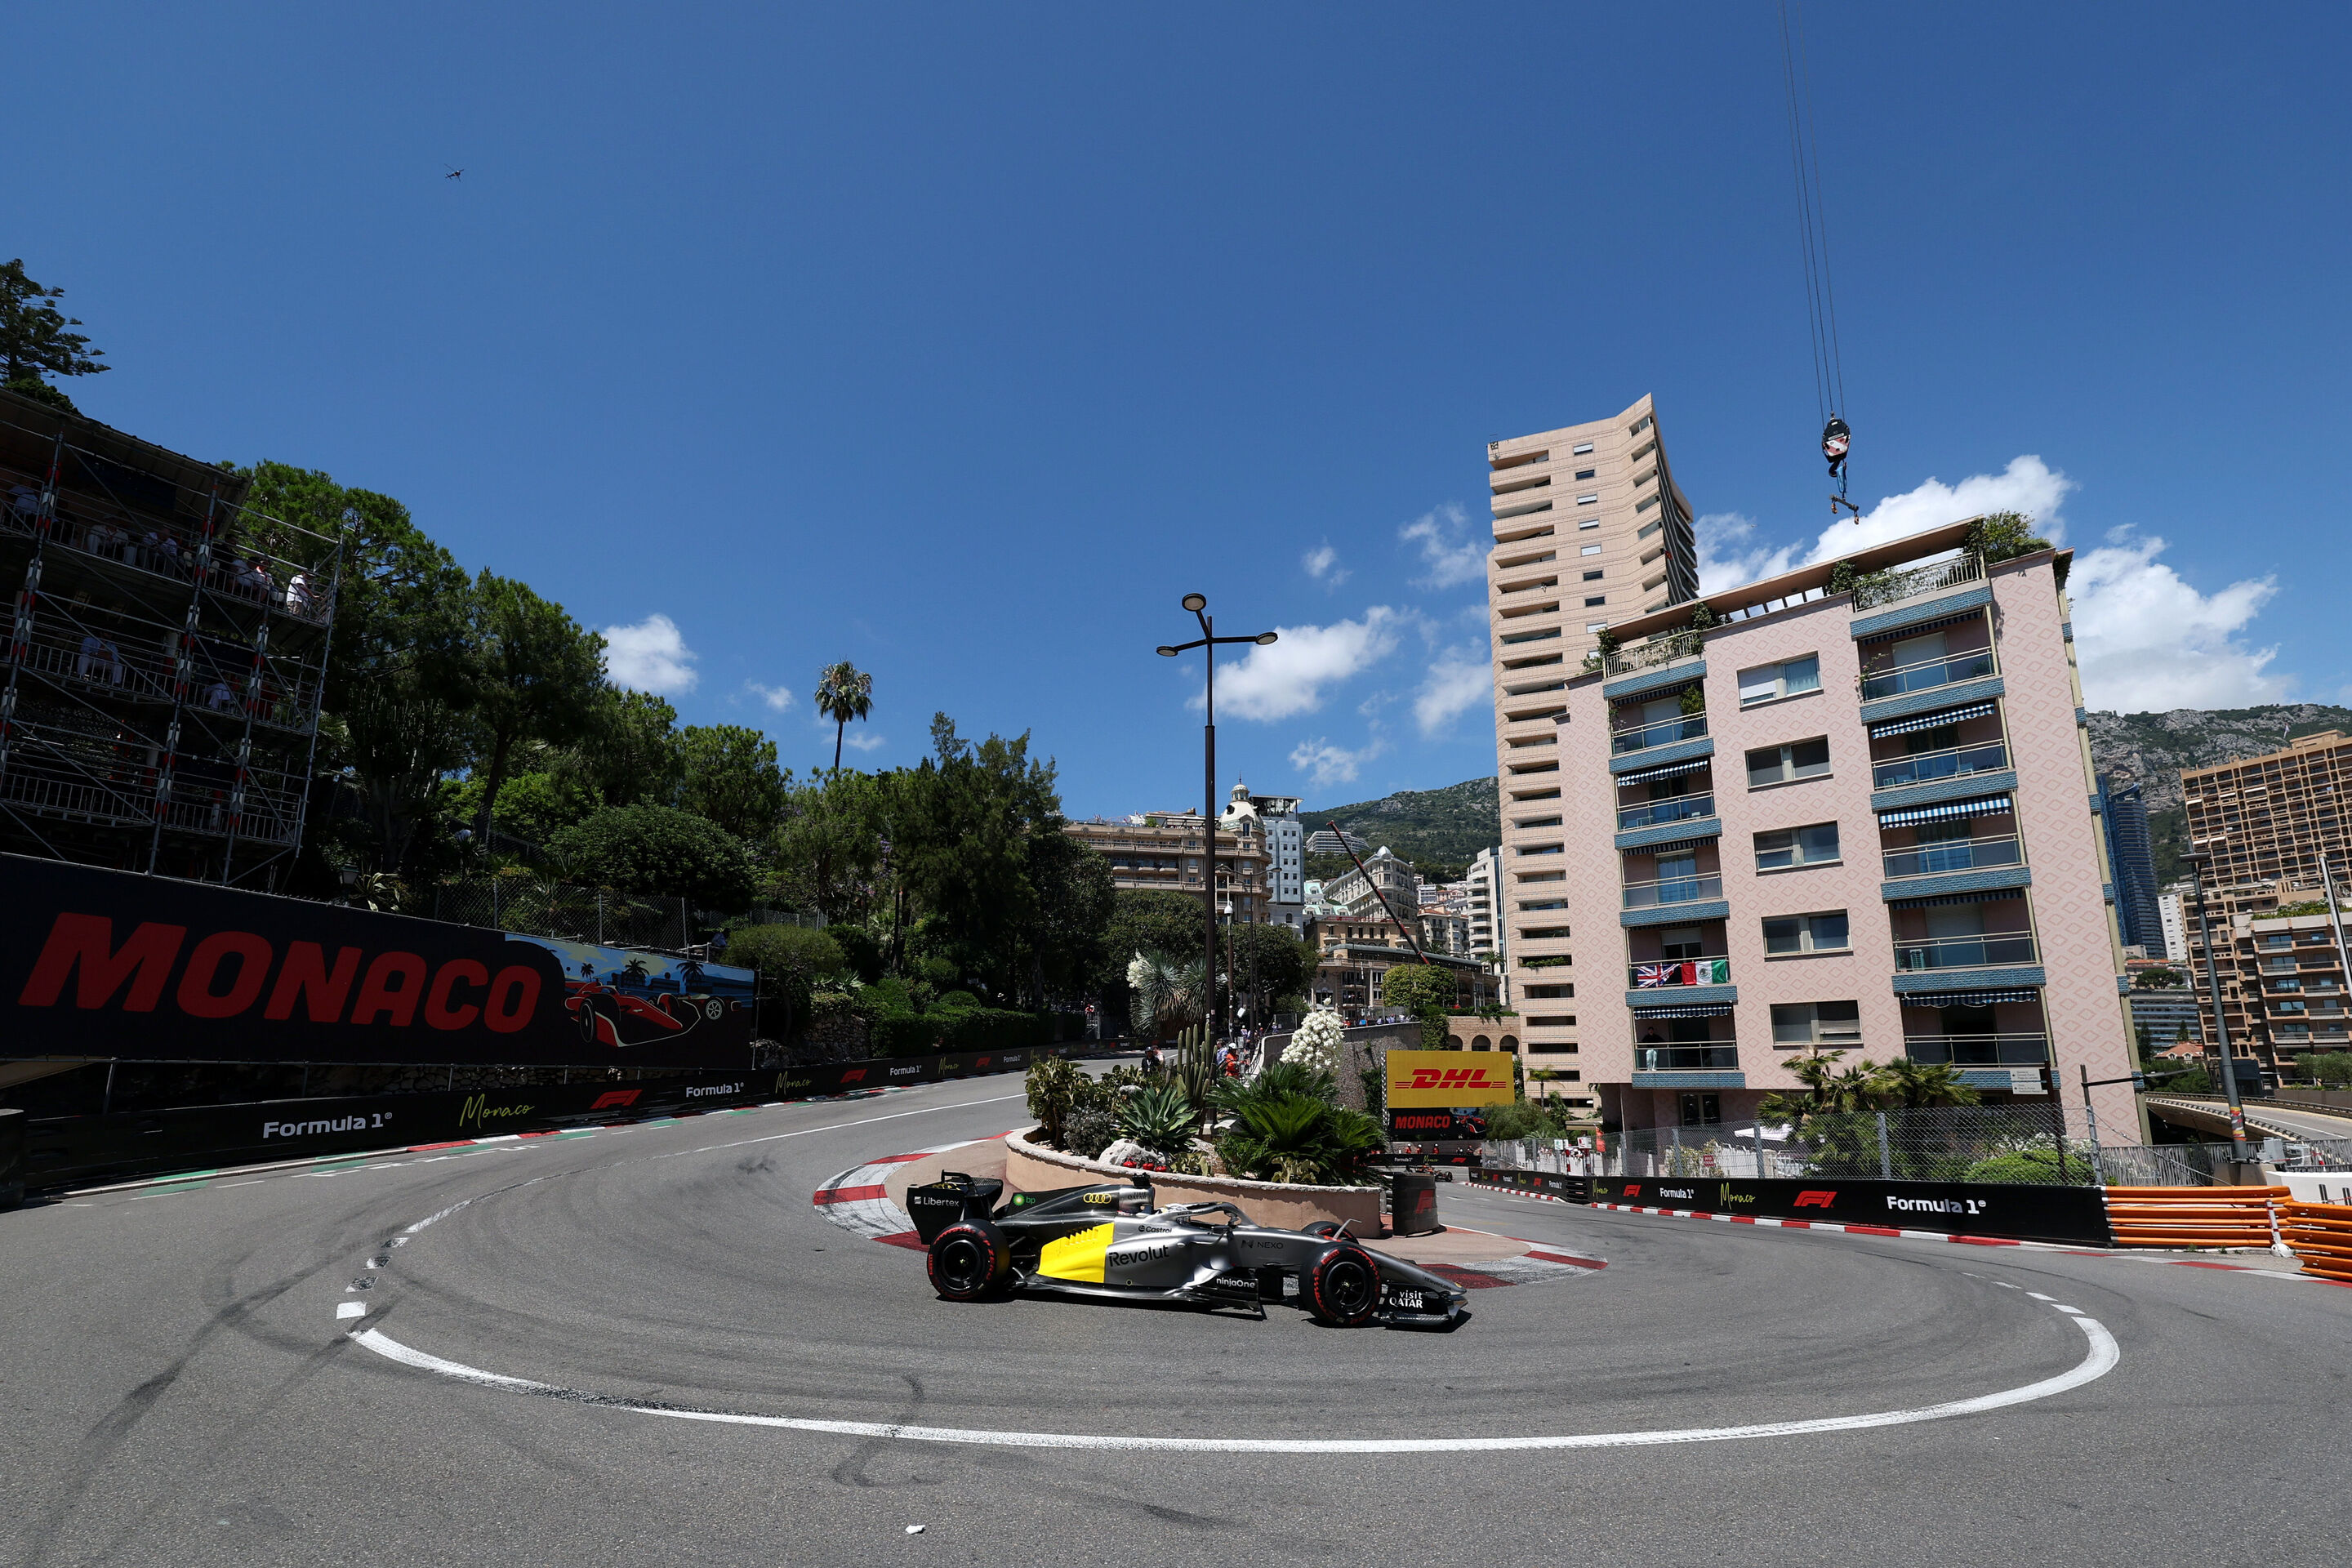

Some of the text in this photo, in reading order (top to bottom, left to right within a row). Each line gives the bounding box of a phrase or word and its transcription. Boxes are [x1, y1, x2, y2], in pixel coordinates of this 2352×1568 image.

[18, 912, 541, 1033] MONACO
[890, 1067, 915, 1076] Formula
[776, 1071, 812, 1095] Monaco
[1410, 1068, 1492, 1089] DHL
[685, 1084, 733, 1098] Formula
[460, 1094, 535, 1129] Monaco
[263, 1115, 366, 1138] Formula
[1395, 1116, 1450, 1129] MONACO
[1659, 1187, 1686, 1199] Formula
[1720, 1182, 1756, 1209] Monaco
[923, 1196, 960, 1207] Libertex
[1026, 1196, 1036, 1205] bp
[1886, 1196, 1962, 1214] Formula
[1145, 1226, 1172, 1234] Castrol
[1257, 1241, 1283, 1250] NEXO
[1108, 1245, 1169, 1267] Revolut
[1216, 1276, 1255, 1289] ninjaOne
[1399, 1290, 1423, 1299] visit
[1389, 1297, 1423, 1308] QATAR
